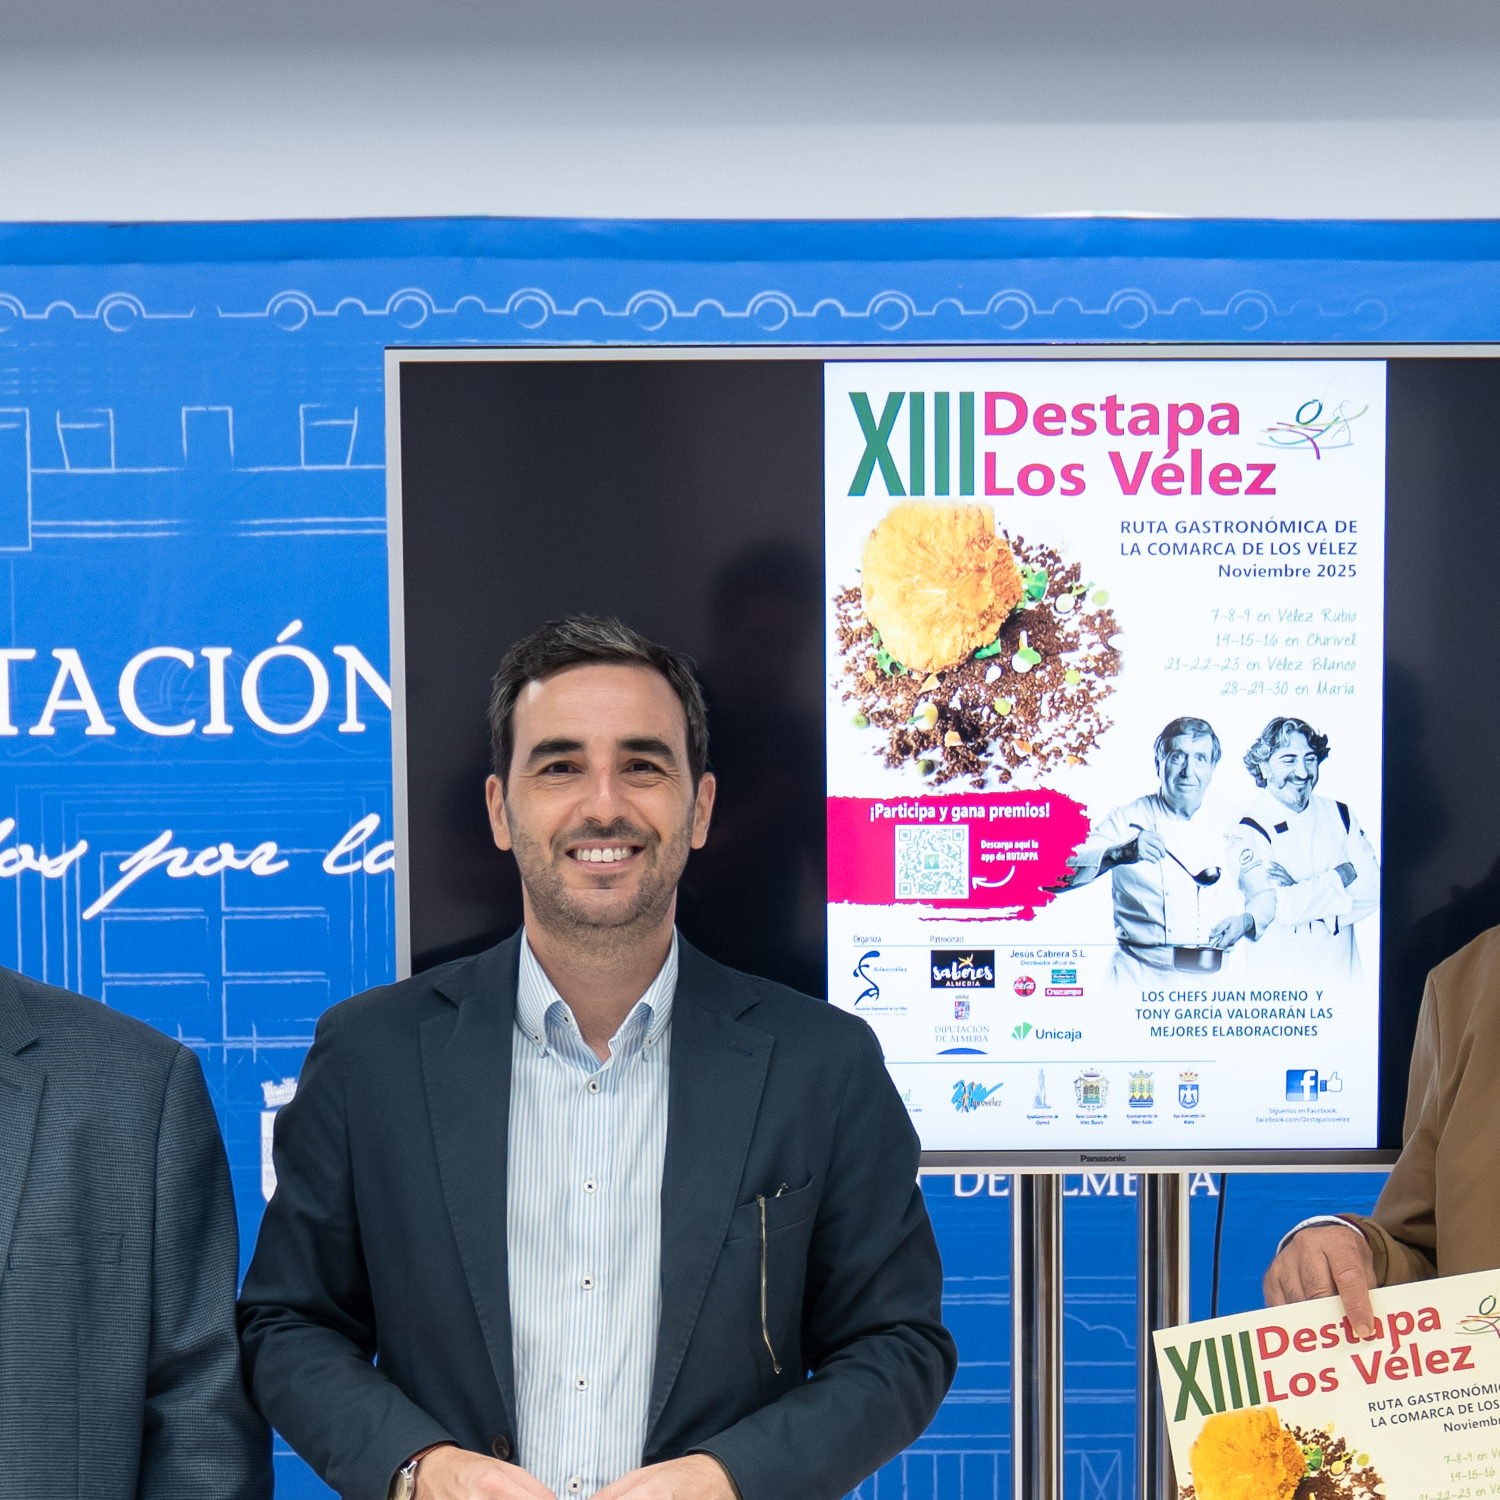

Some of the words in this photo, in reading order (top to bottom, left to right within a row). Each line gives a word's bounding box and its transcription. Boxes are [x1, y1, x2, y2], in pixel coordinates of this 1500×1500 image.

[984, 391, 1240, 450] Destapa
[847, 391, 975, 496] XIII
[984, 451, 1087, 497] Los
[1108, 447, 1277, 497] Vélez
[1120, 520, 1168, 534] RUTA
[1175, 516, 1328, 534] GASTRONÓMICA
[1335, 520, 1358, 534] DE
[1120, 542, 1141, 556] LA
[1147, 542, 1236, 556] COMARCA
[1242, 542, 1264, 556] DE
[1270, 542, 1301, 556] LOS
[1307, 538, 1358, 556] VÉLEZ
[1218, 564, 1311, 578] Noviembre
[1317, 564, 1357, 578] 2025
[1211, 608, 1250, 623] 7-8-9
[1257, 611, 1271, 623] en
[1278, 608, 1314, 623] Vélez
[1320, 608, 1357, 623] Rubio
[1215, 633, 1279, 647] 14-15-16
[1285, 636, 1299, 647] en
[1306, 632, 1357, 647] Chirivel
[1164, 657, 1240, 671] 21-22-23
[1246, 660, 1260, 671] en
[1267, 656, 1303, 671] Vélez
[1312, 656, 1357, 671] Blanco
[1220, 681, 1289, 695] 28-29-30
[1295, 684, 1309, 695] en
[1316, 681, 1355, 695] María
[870, 802, 936, 822] ¡Participa
[939, 805, 948, 822] y
[951, 805, 986, 822] gana
[989, 802, 1051, 822] premios!
[980, 840, 1013, 851] Descarga
[1031, 840, 1039, 849] la
[980, 853, 995, 862] app
[996, 851, 1005, 861] de
[84, 829, 289, 919] por
[853, 935, 882, 945] Organiza
[1009, 949, 1035, 958] Jesús
[1036, 949, 1070, 958] Cabrera
[932, 961, 994, 981] sabores
[1141, 991, 1165, 1002] LOS
[1168, 990, 1208, 1002] CHEFS
[1211, 990, 1246, 1002] JUAN
[1250, 990, 1308, 1002] MORENO
[1315, 990, 1324, 1001] Y
[1135, 1008, 1171, 1019] TONY
[1174, 1005, 1223, 1019] GARCÍA
[1227, 1004, 1306, 1019] VALORARÁN
[1310, 1008, 1333, 1019] LAS
[1035, 1028, 1082, 1042] Unicaja
[1150, 1026, 1208, 1037] MEJORES
[1212, 1025, 1318, 1037] ELABORACIONES
[935, 1035, 946, 1043] DE
[1080, 1154, 1126, 1163] Panasonic
[1163, 1330, 1261, 1422] XIII
[1263, 1367, 1340, 1402] Los
[1351, 1342, 1476, 1385] Vélez
[1368, 1398, 1403, 1412] RUTA
[1370, 1416, 1387, 1428] LA
[1390, 1406, 1455, 1425] COMARCA
[1458, 1402, 1474, 1415] DE
[1477, 1398, 1500, 1412] LOS
[1477, 1453, 1488, 1461] en
[1475, 1489, 1486, 1497] en
